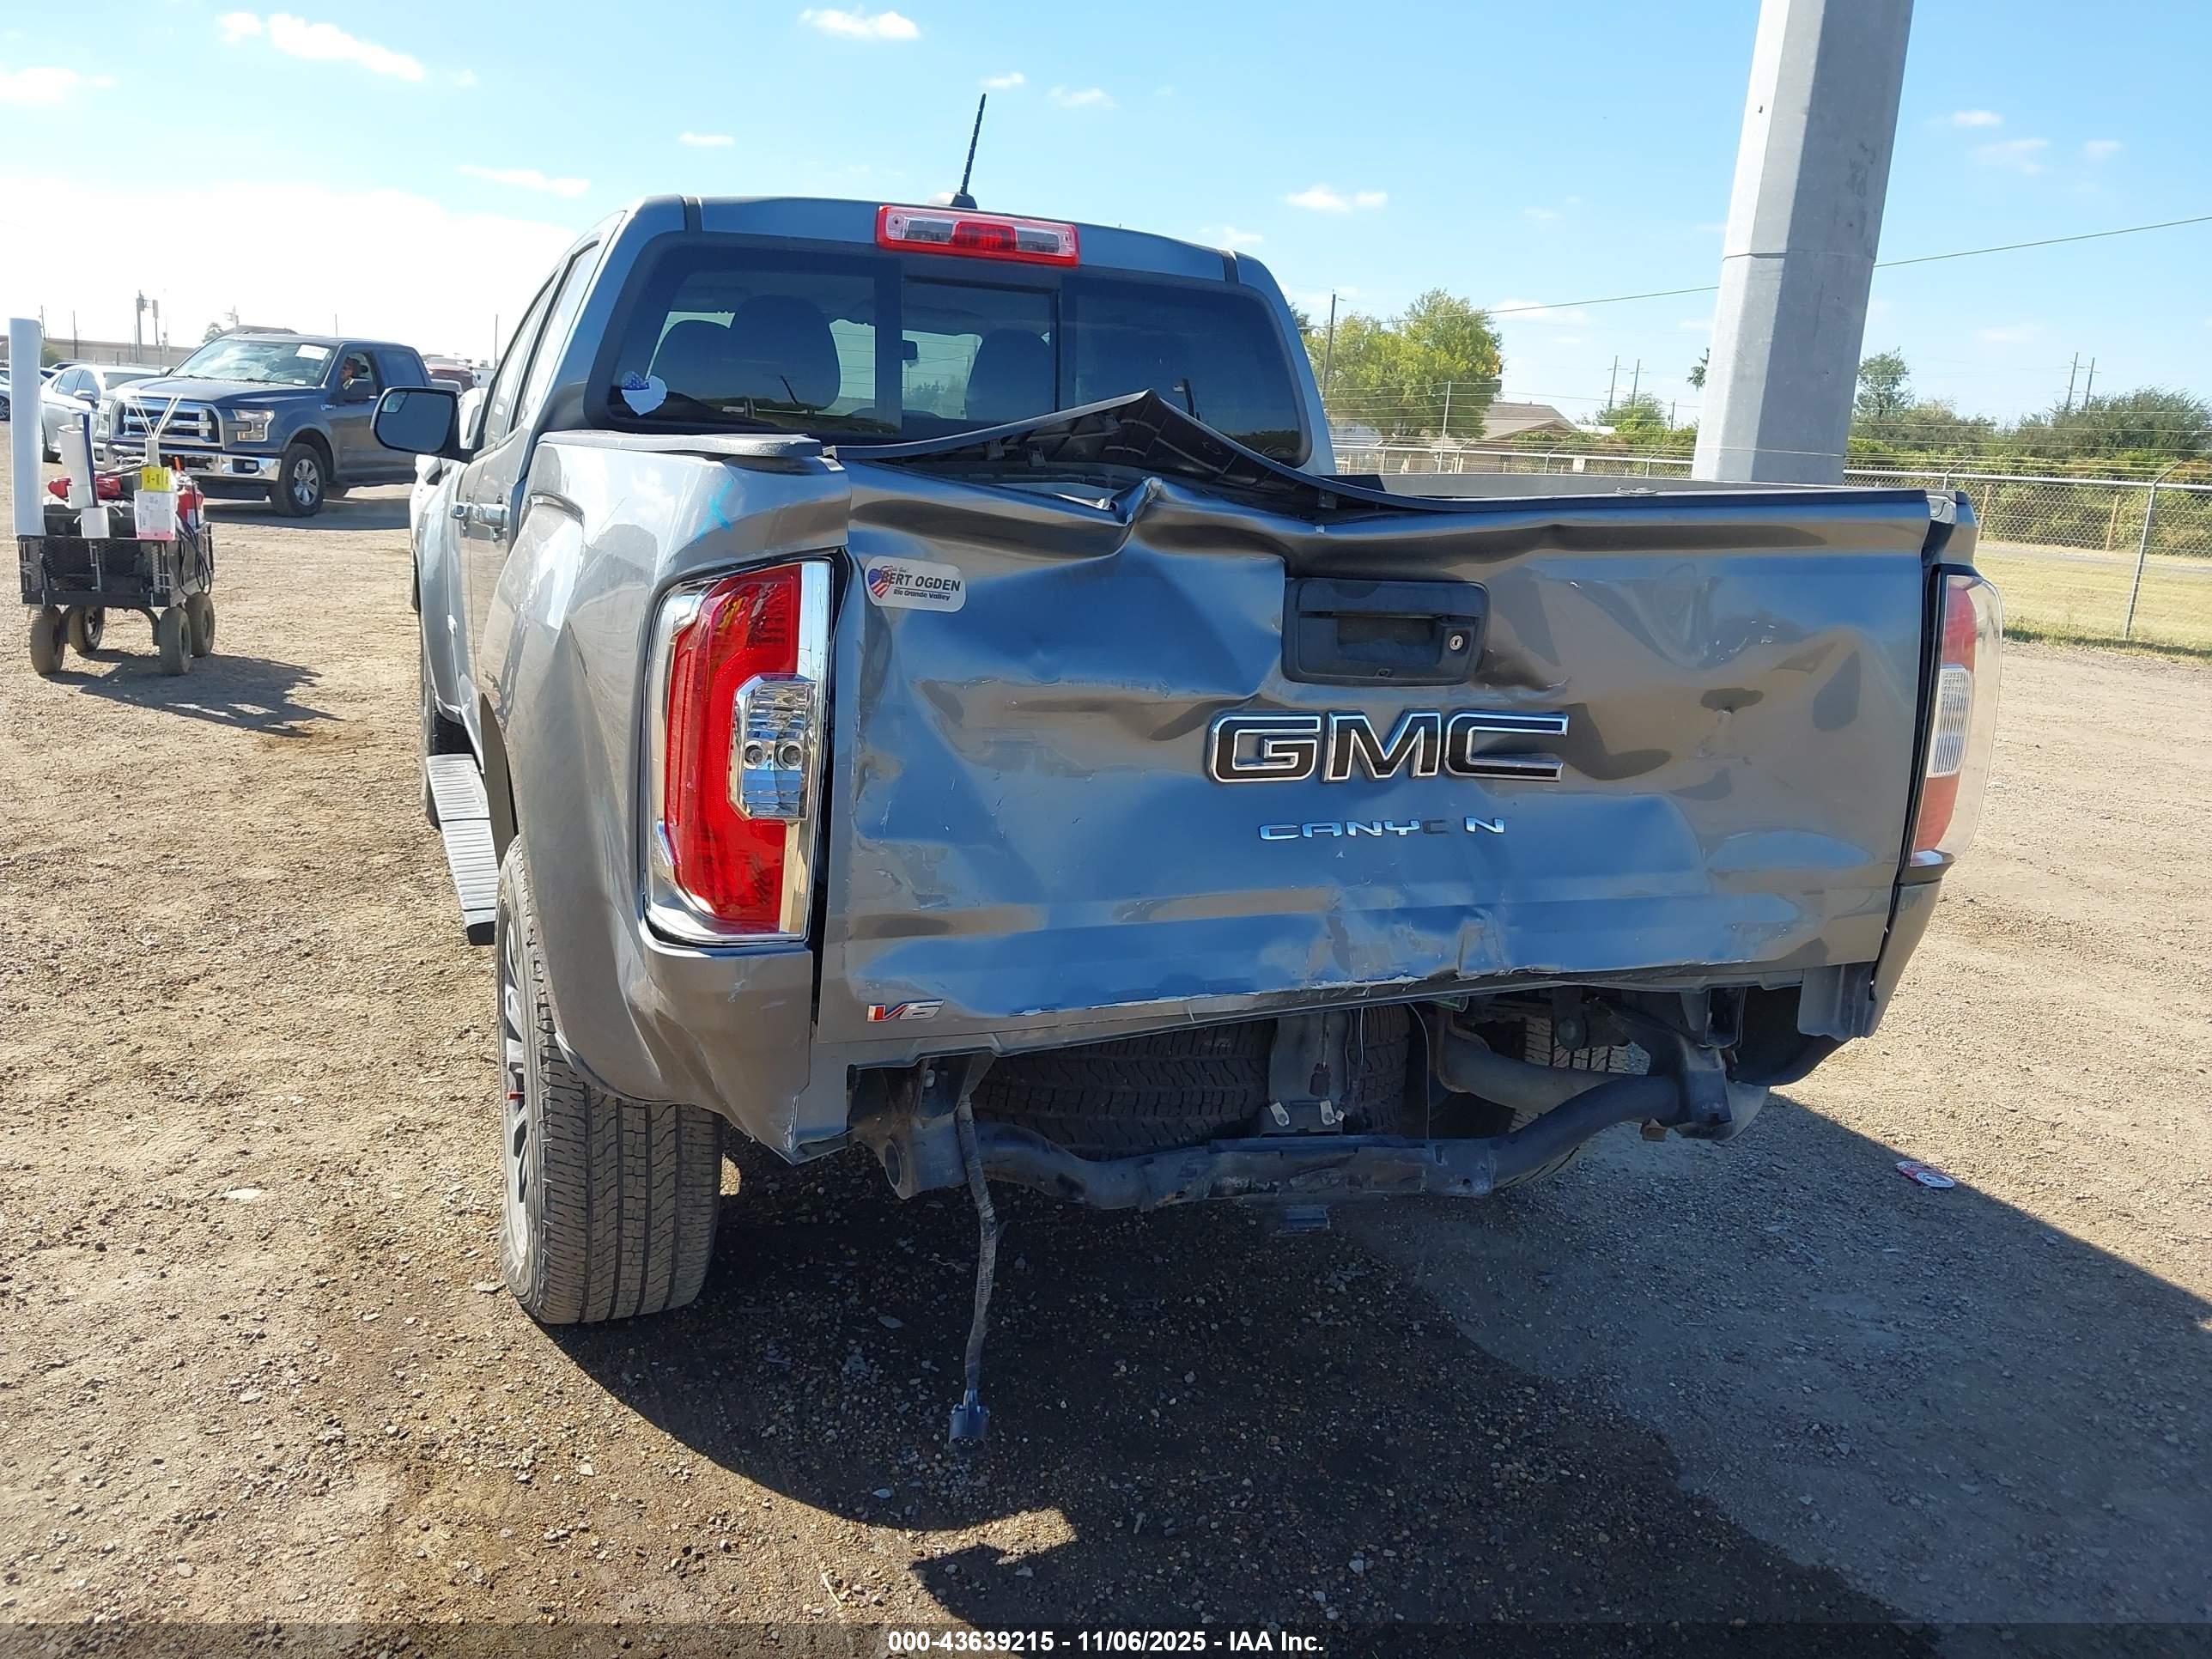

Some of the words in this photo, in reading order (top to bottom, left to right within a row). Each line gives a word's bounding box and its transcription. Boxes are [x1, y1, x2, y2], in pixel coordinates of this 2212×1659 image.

[880, 570, 913, 586] BERT
[915, 575, 961, 591] OGDEN
[904, 590, 927, 599] Grande
[928, 592, 951, 602] Valley
[1209, 708, 1570, 782] GMC
[866, 1000, 945, 1022] V6
